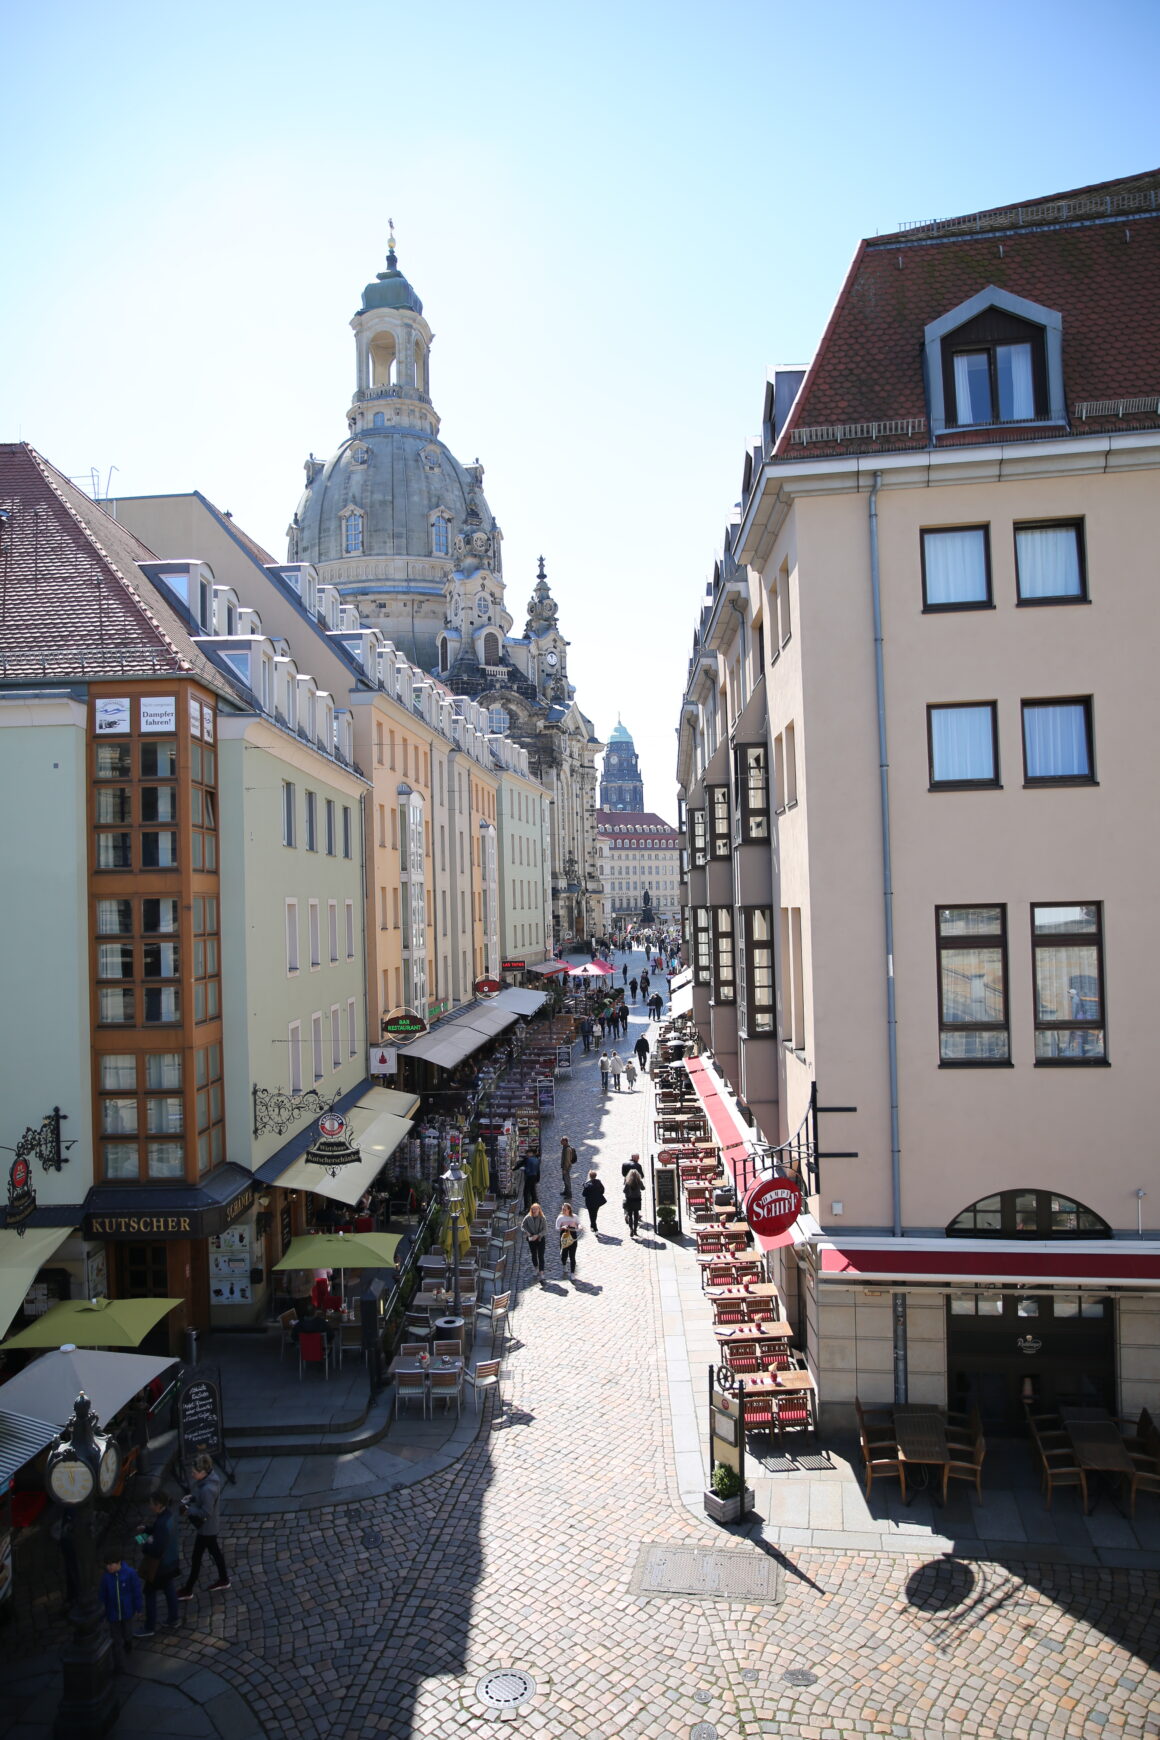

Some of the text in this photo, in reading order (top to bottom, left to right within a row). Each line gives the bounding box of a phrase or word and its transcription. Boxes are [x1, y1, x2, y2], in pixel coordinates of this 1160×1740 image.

[142, 711, 174, 719] Dampfer
[145, 718, 171, 726] fahren!
[763, 1190, 790, 1204] DAMPF
[92, 1217, 191, 1233] KUTSCHER
